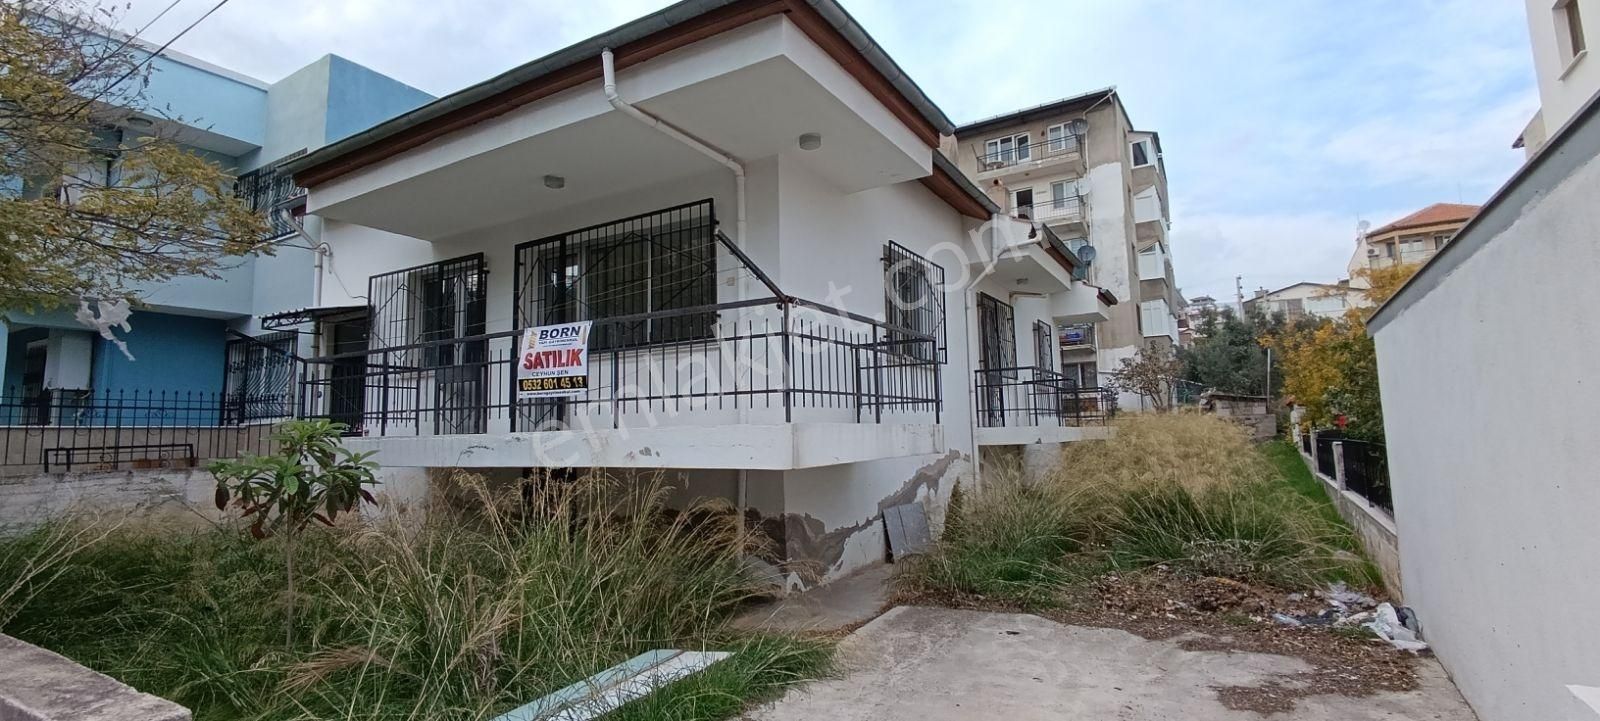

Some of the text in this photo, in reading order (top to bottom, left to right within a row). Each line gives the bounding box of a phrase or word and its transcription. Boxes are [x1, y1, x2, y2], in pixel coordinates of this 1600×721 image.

[538, 326, 581, 339] BORN
[523, 348, 584, 370] SATILIK
[523, 377, 583, 391] 0532 601 45 13
